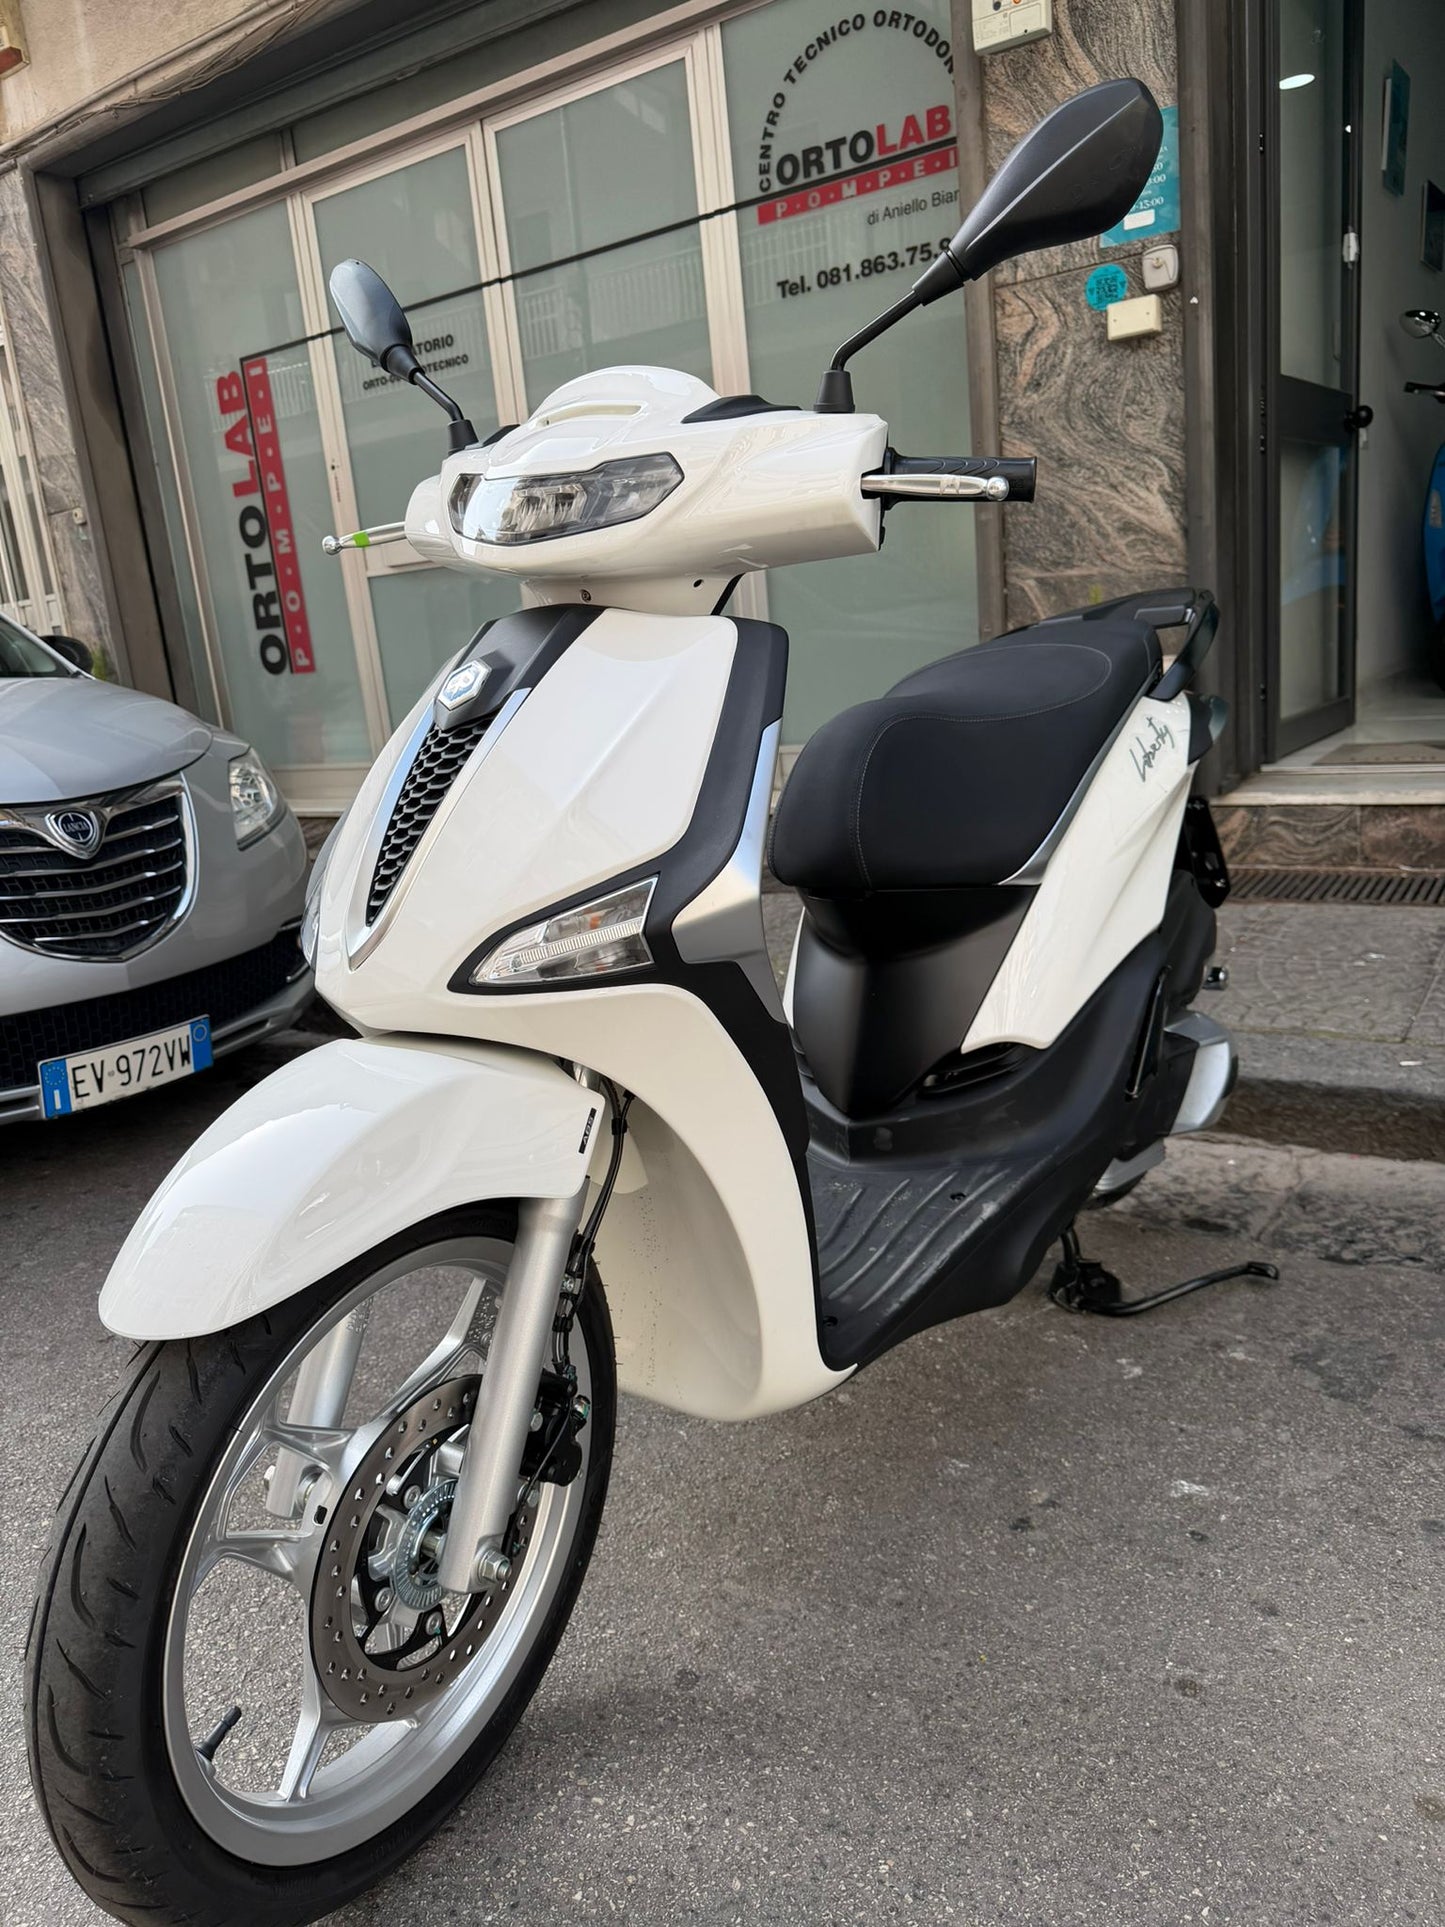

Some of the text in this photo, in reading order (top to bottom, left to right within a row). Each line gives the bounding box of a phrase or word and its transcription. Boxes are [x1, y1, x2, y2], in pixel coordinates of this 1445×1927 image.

[759, 92, 786, 193] CENTRO
[783, 13, 866, 85] TECNICO
[776, 104, 952, 186] ORTOLAB
[867, 210, 879, 226] di
[882, 199, 928, 221] Aniello
[777, 275, 812, 299] Tel.
[216, 370, 288, 675] ORTOLAB
